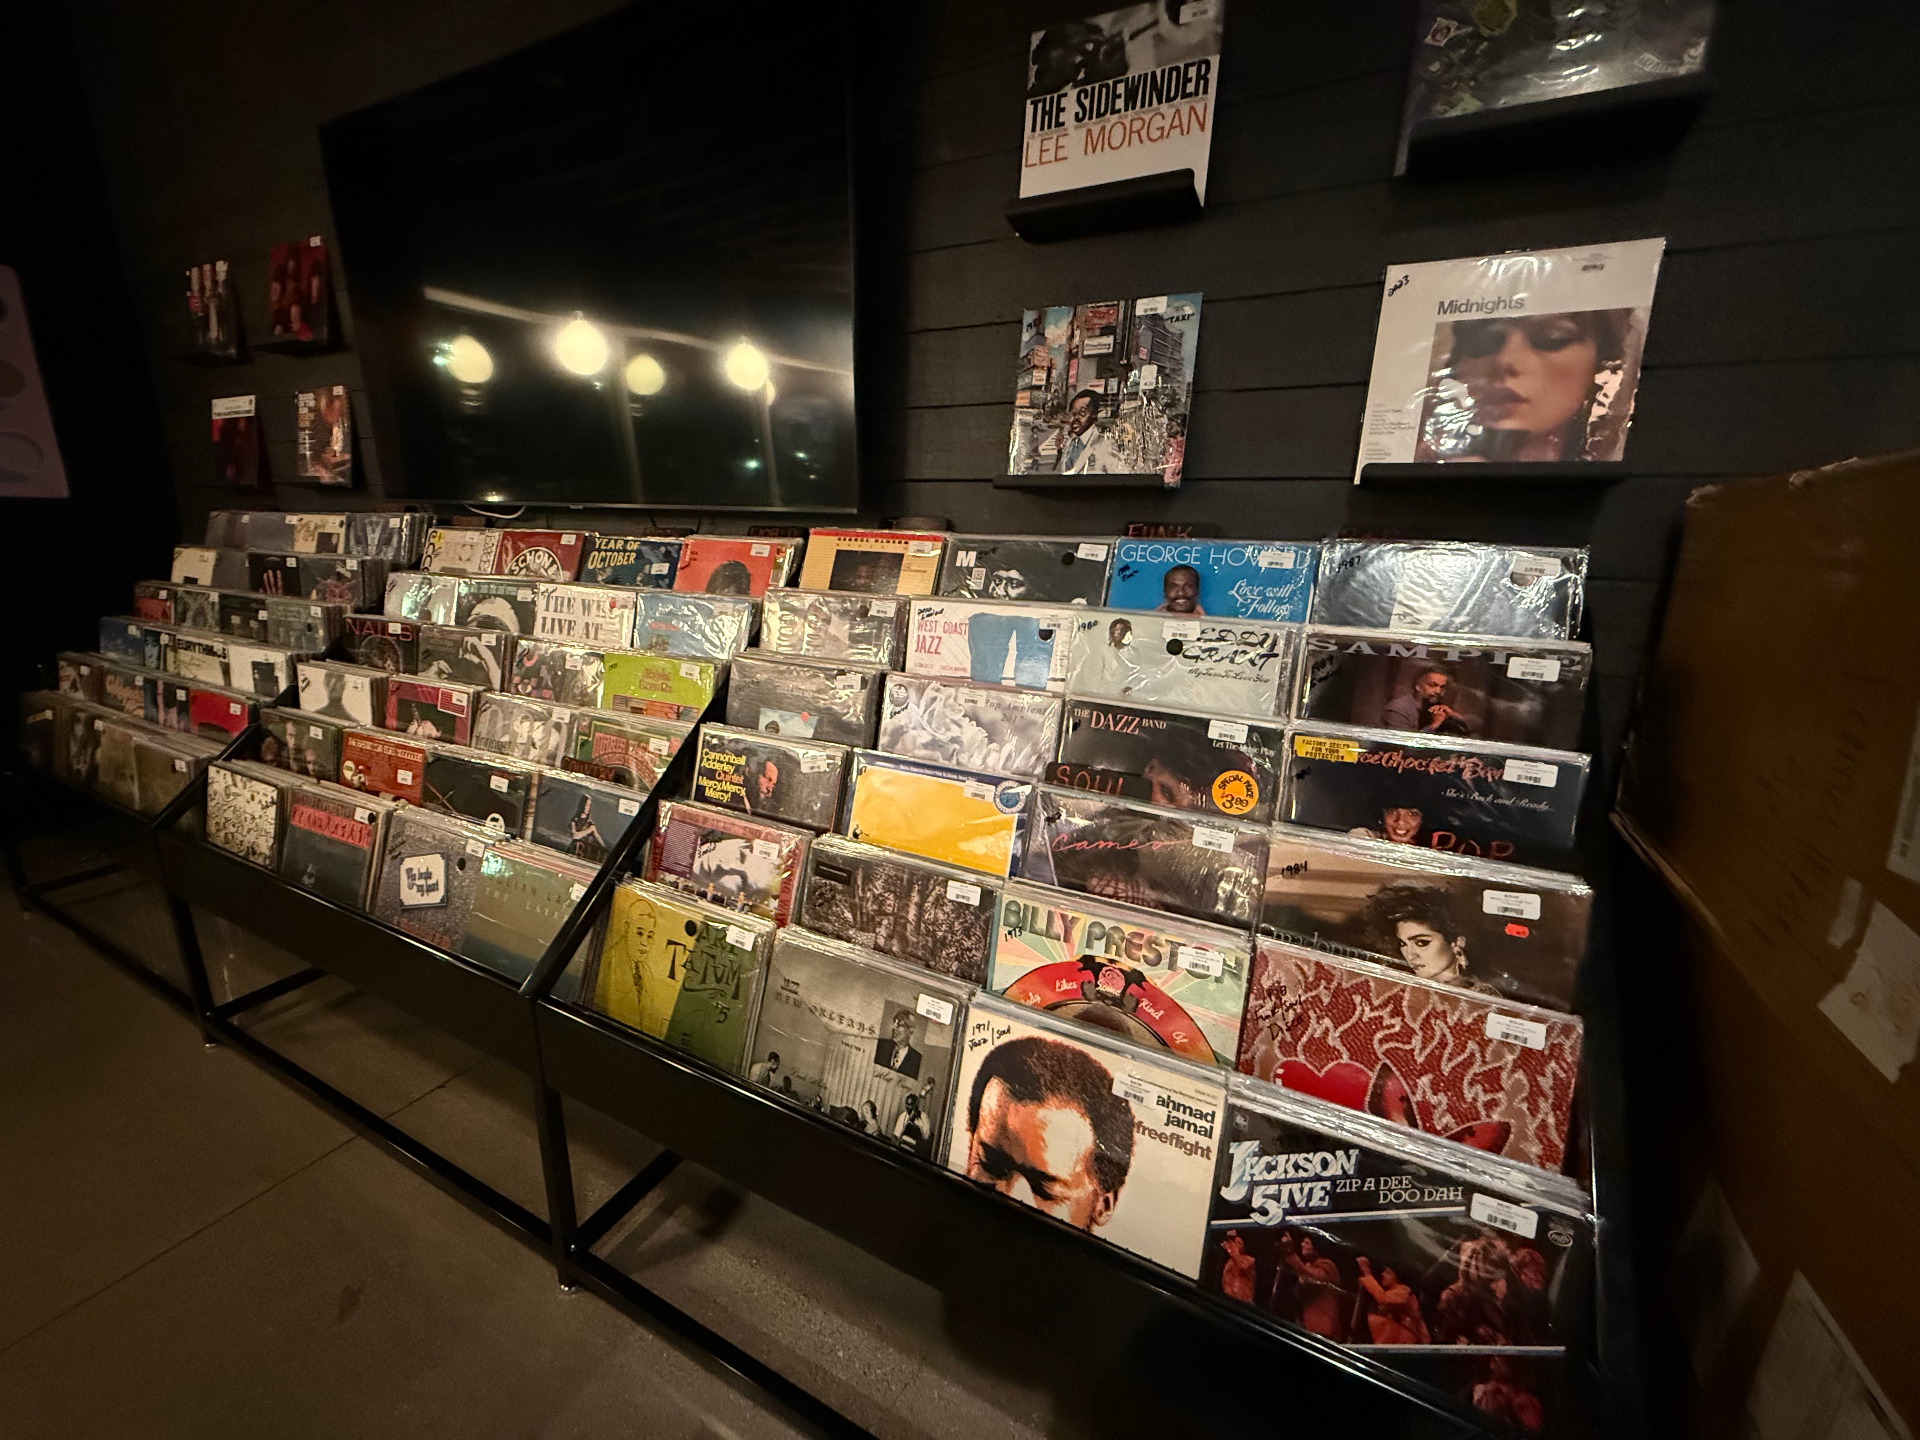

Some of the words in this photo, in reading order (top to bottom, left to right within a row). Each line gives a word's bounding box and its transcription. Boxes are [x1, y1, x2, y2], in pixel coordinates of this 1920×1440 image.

[1030, 93, 1068, 132] THE
[1075, 58, 1210, 122] SIDEWINDER
[1025, 134, 1068, 168] LEE
[1084, 104, 1207, 156] MORGAN
[1438, 294, 1524, 316] Midnights
[595, 538, 624, 550] YEAR
[626, 540, 640, 550] OF
[512, 550, 550, 574] SCHON
[588, 551, 636, 570] OCTOBER
[1120, 544, 1201, 564] GEORGE
[1209, 546, 1310, 568] HOWD
[1336, 555, 1362, 574] 1987
[1264, 583, 1294, 598] will
[543, 594, 575, 614] THE
[541, 616, 576, 637] LIVE
[580, 622, 602, 640] AT
[917, 620, 938, 632] WEST
[943, 620, 968, 636] COAST
[1078, 620, 1098, 632] 1980
[177, 638, 227, 659] EURYTHMS
[914, 636, 943, 654] JAZZ
[1196, 628, 1278, 652] EDDY
[1182, 646, 1279, 671] GRANT
[985, 699, 1001, 710] Pop
[1006, 702, 1046, 715] Ambient
[1074, 708, 1090, 718] THE
[1090, 710, 1140, 734] DAZZ
[1142, 719, 1166, 729] BAND
[1212, 740, 1224, 748] Let
[1225, 741, 1238, 750] The
[1260, 748, 1276, 758] Play
[1302, 740, 1326, 748] FACTORY
[702, 748, 746, 765] Cannonball
[1305, 751, 1345, 760] PROTECTION
[700, 759, 735, 774] Adderley
[716, 770, 744, 784] Quintet
[1218, 774, 1243, 790] SPECIAL
[1243, 780, 1254, 799] PRICE
[705, 788, 731, 802] Mercy!
[1052, 833, 1190, 851] Cameo
[1281, 861, 1308, 877] 1984
[526, 902, 568, 920] LAYE
[1003, 900, 1081, 944] BILLY
[1004, 927, 1022, 942] 1973
[665, 939, 742, 1000] TATUM
[1055, 979, 1077, 992] Likes
[1096, 980, 1121, 996] Some
[1138, 998, 1163, 1022] Kind
[809, 1004, 877, 1035] ORLEANS
[971, 1021, 990, 1036] 1971
[1156, 1094, 1216, 1124] ahmad
[1164, 1111, 1214, 1139] jamal
[1136, 1120, 1212, 1161] freeflight
[1220, 1140, 1360, 1202] JACKSON
[1336, 1180, 1362, 1192] ZIP
[1362, 1178, 1375, 1191] A
[1379, 1176, 1412, 1190] DEE
[1249, 1182, 1332, 1226] 5IVE
[1378, 1190, 1420, 1204] DOO
[1423, 1186, 1464, 1202] DAH
